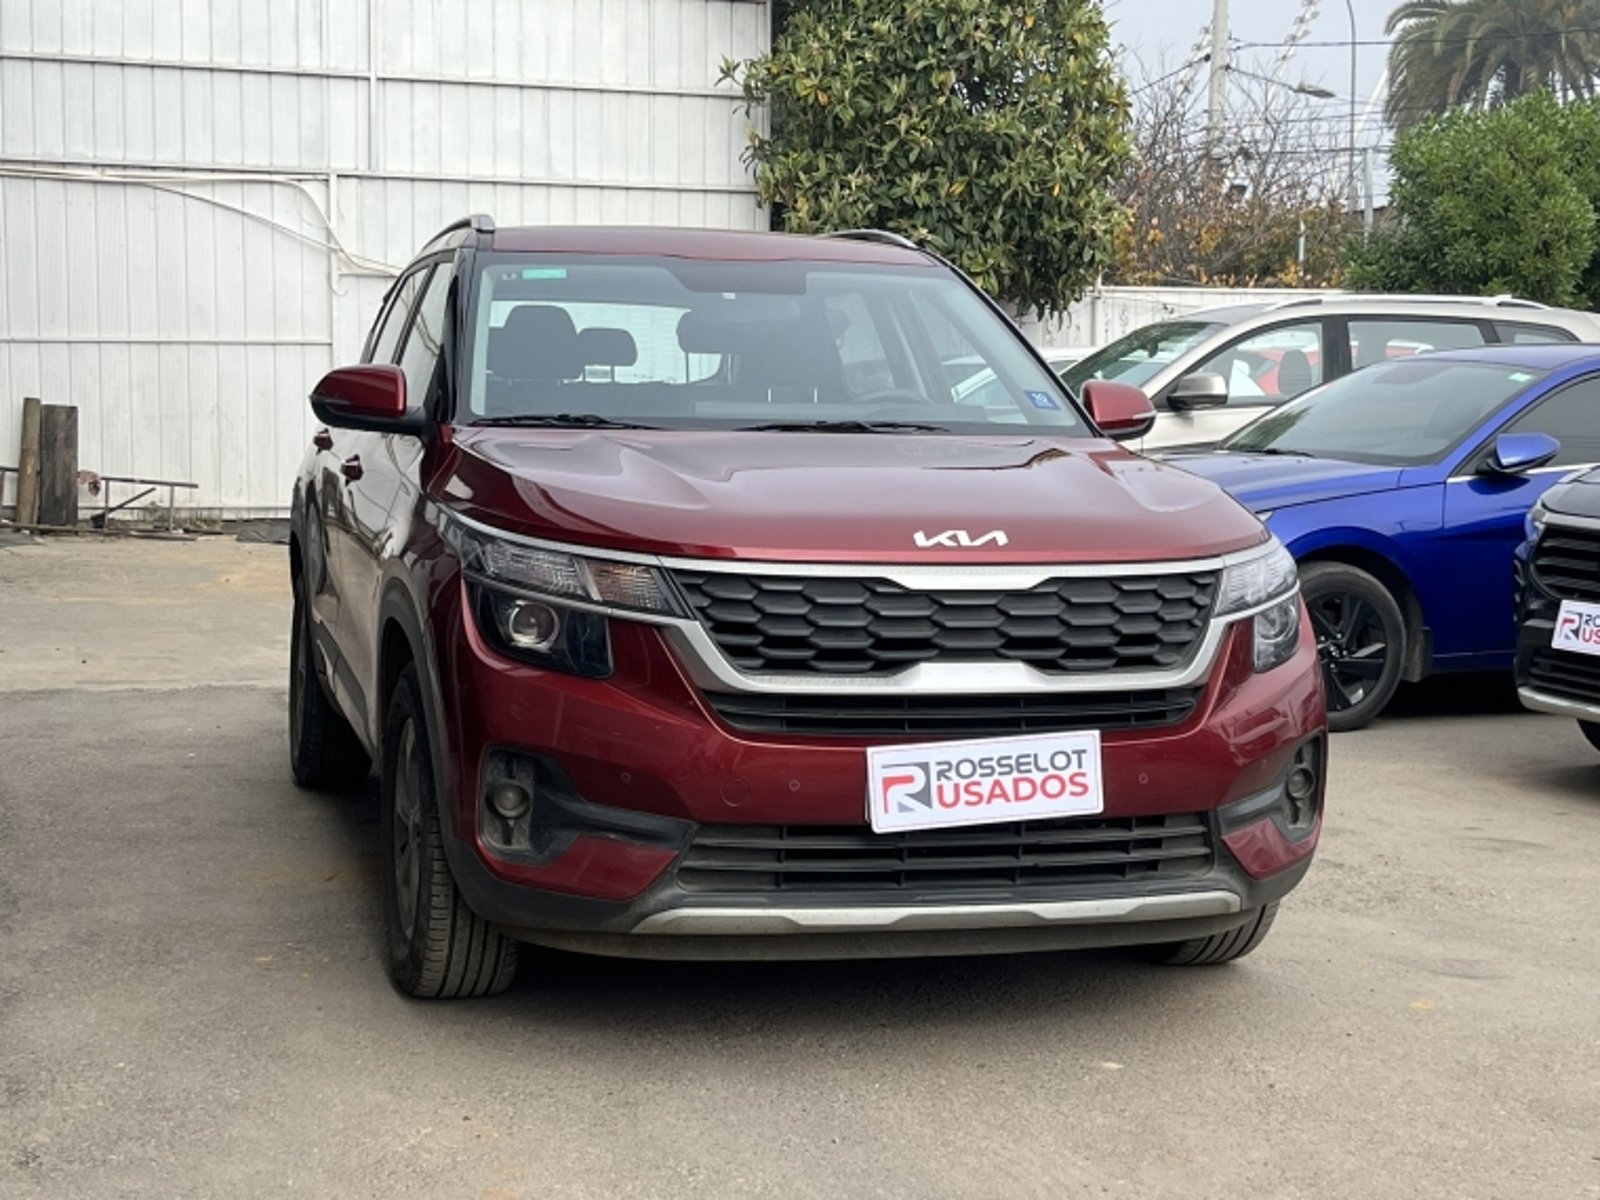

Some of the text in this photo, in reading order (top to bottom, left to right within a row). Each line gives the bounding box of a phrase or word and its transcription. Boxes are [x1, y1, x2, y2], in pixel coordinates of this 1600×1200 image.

[913, 529, 1009, 548] KIA
[936, 749, 1087, 781] ROSSELOT
[937, 772, 1089, 809] USADOS
